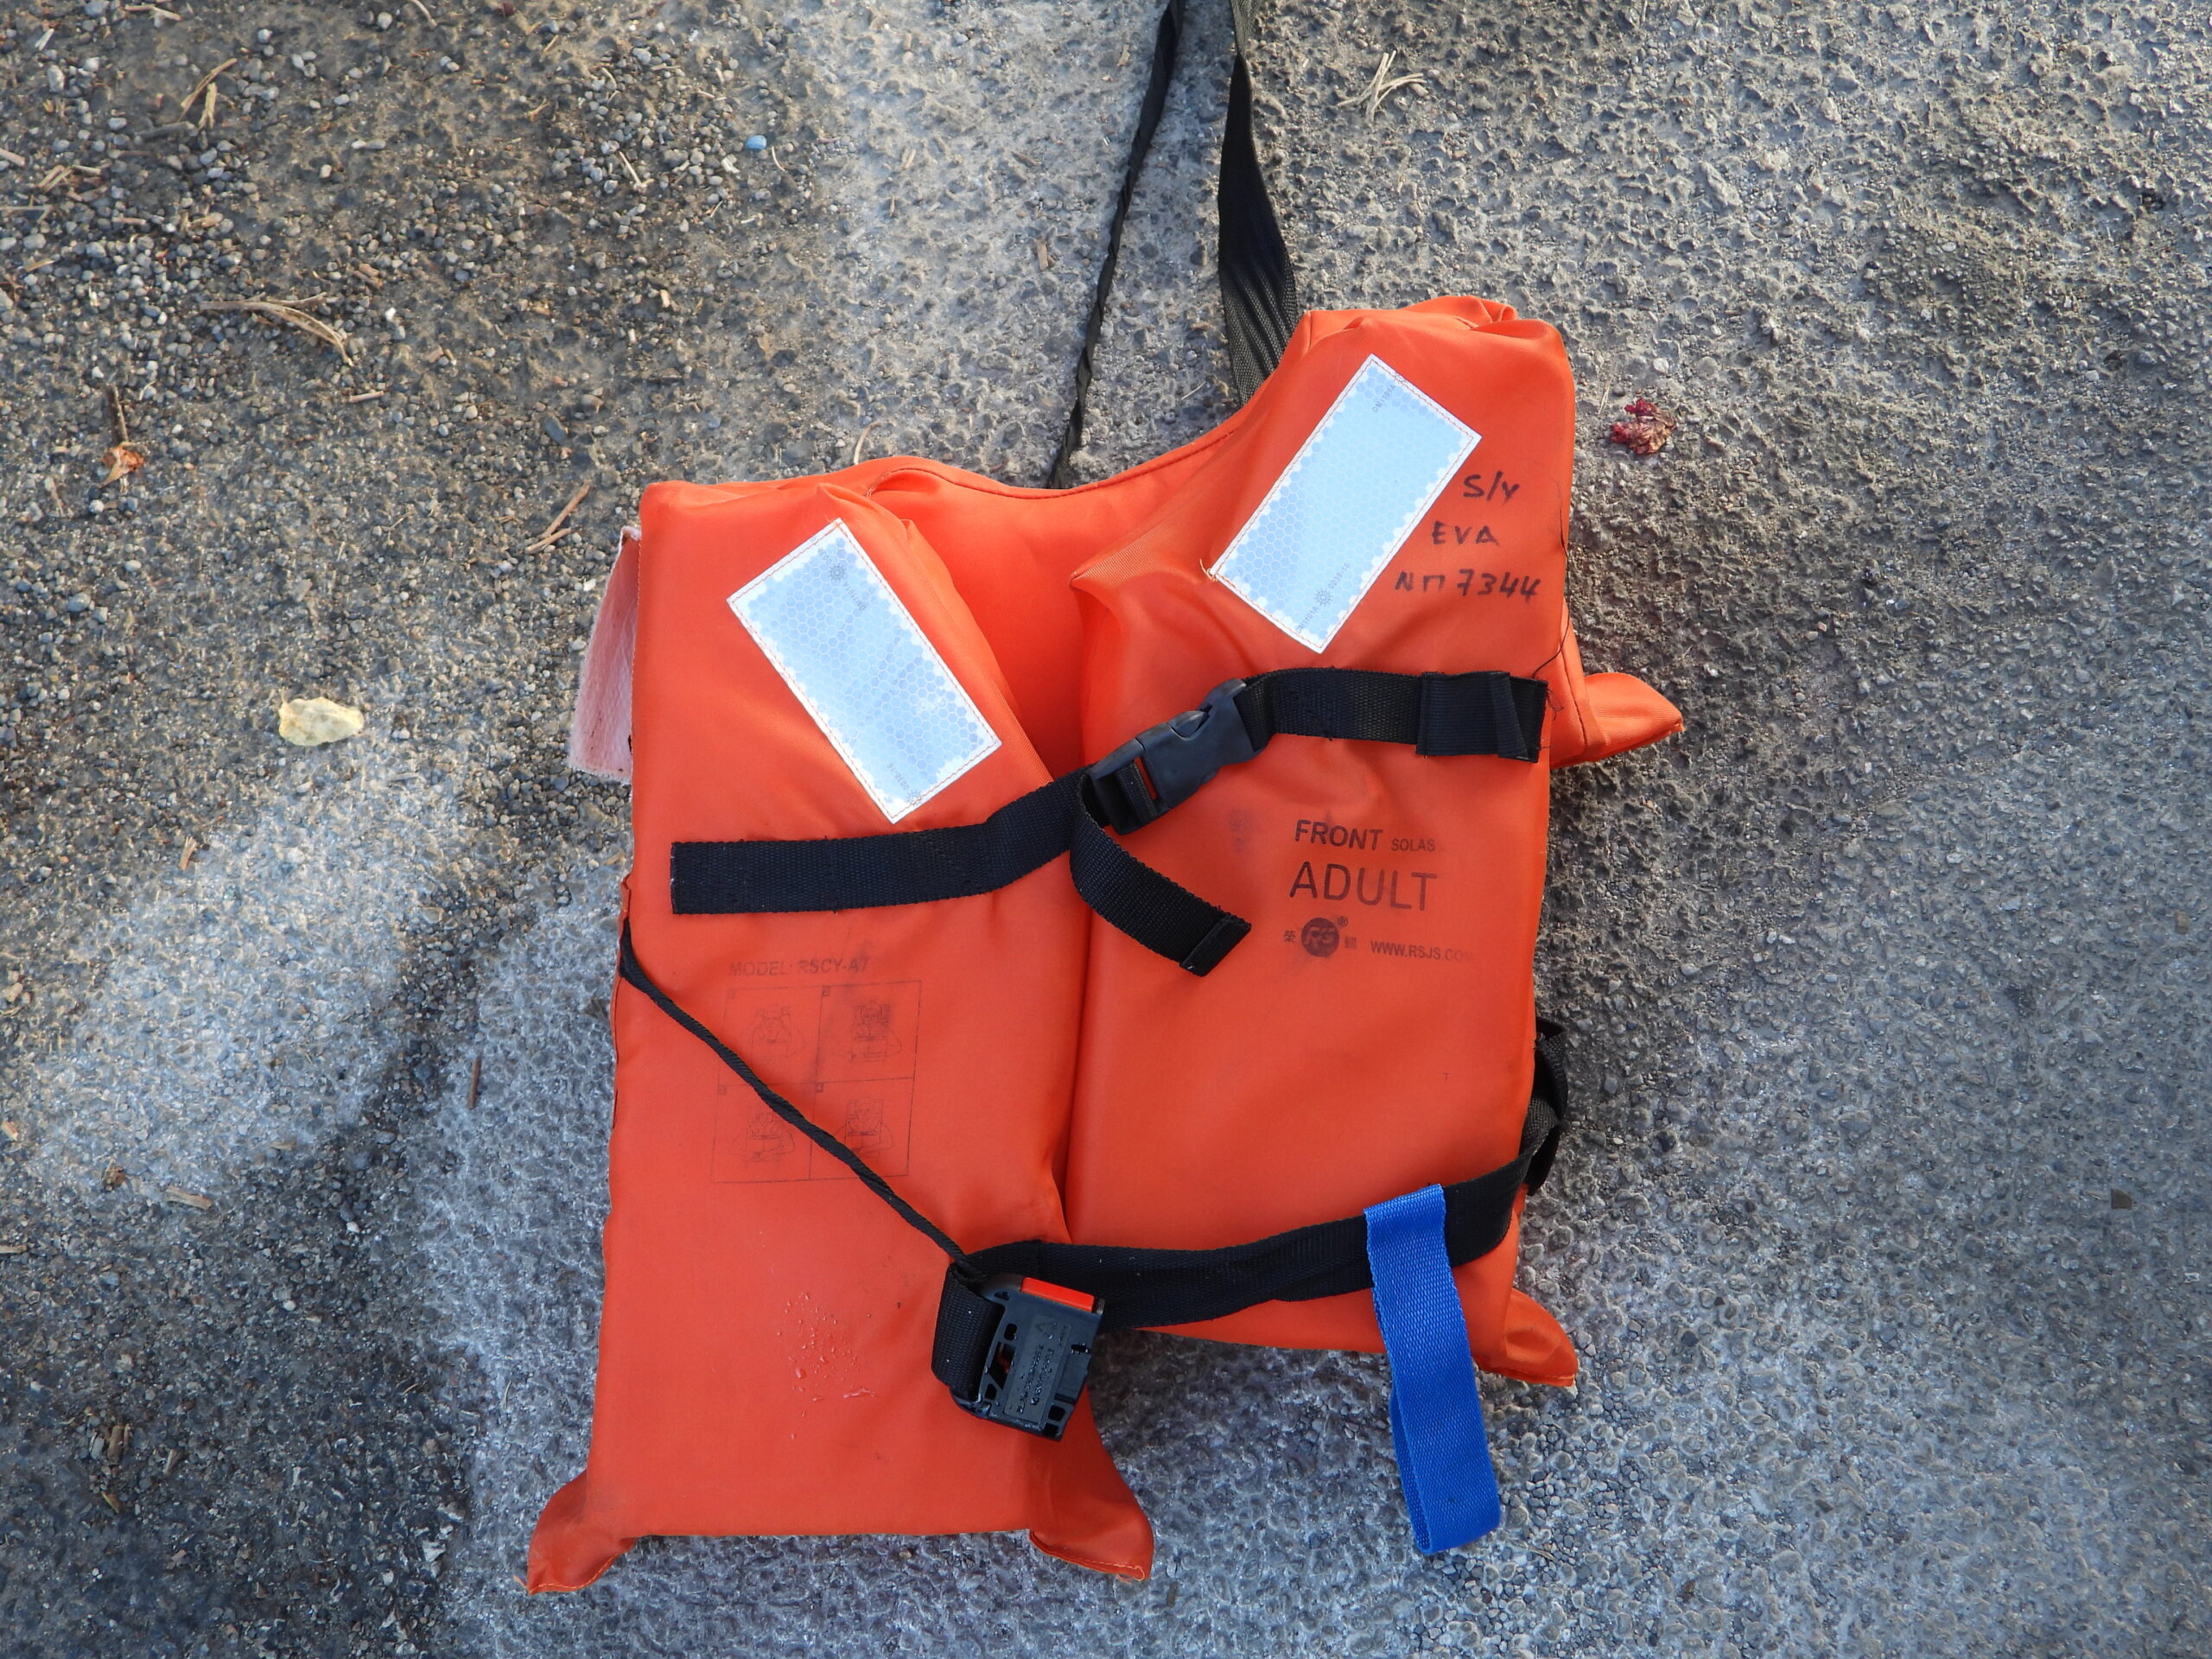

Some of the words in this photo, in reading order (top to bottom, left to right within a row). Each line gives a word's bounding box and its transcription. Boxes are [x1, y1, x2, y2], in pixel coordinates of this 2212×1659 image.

[1432, 521, 1500, 546] EVA
[1458, 569, 1541, 603] 7344
[1295, 819, 1383, 850] FRONT
[1390, 838, 1435, 852] SOLAS
[1289, 861, 1437, 911] ADULT
